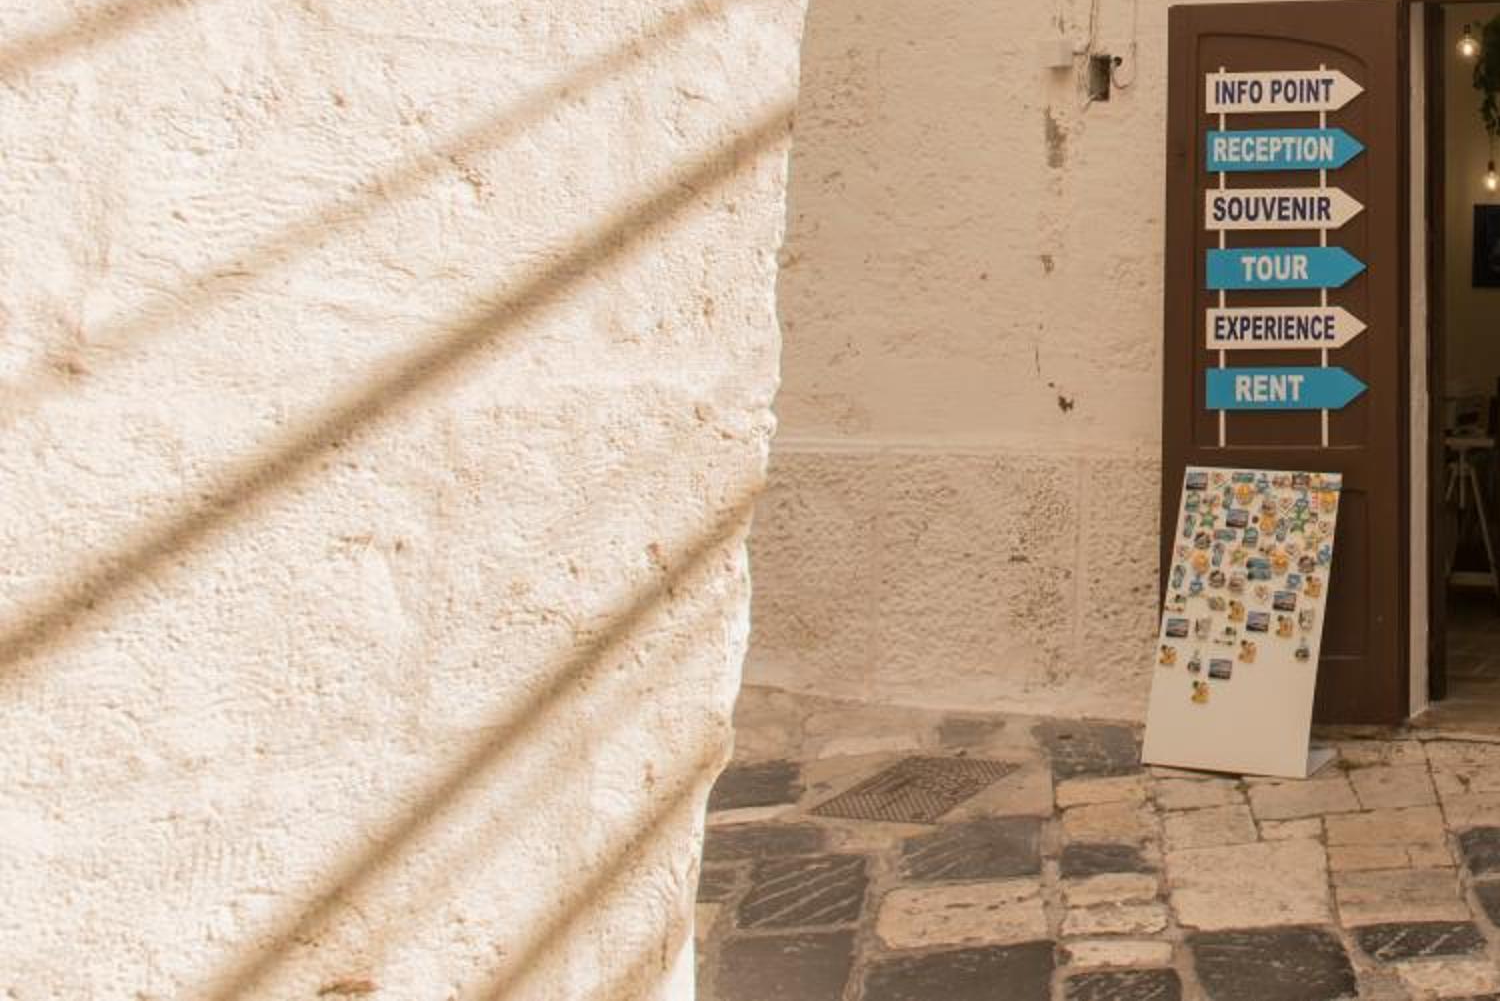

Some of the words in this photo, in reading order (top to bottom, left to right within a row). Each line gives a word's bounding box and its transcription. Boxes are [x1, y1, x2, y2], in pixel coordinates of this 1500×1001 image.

[1214, 80, 1263, 104] INFO
[1269, 78, 1334, 104] POINT
[1212, 136, 1334, 163] RECEPTION
[1212, 196, 1332, 222] SOUVENIR
[1241, 254, 1309, 281] TOUR
[1213, 315, 1336, 341] EXPERIENCE
[1235, 374, 1305, 402] RENT
